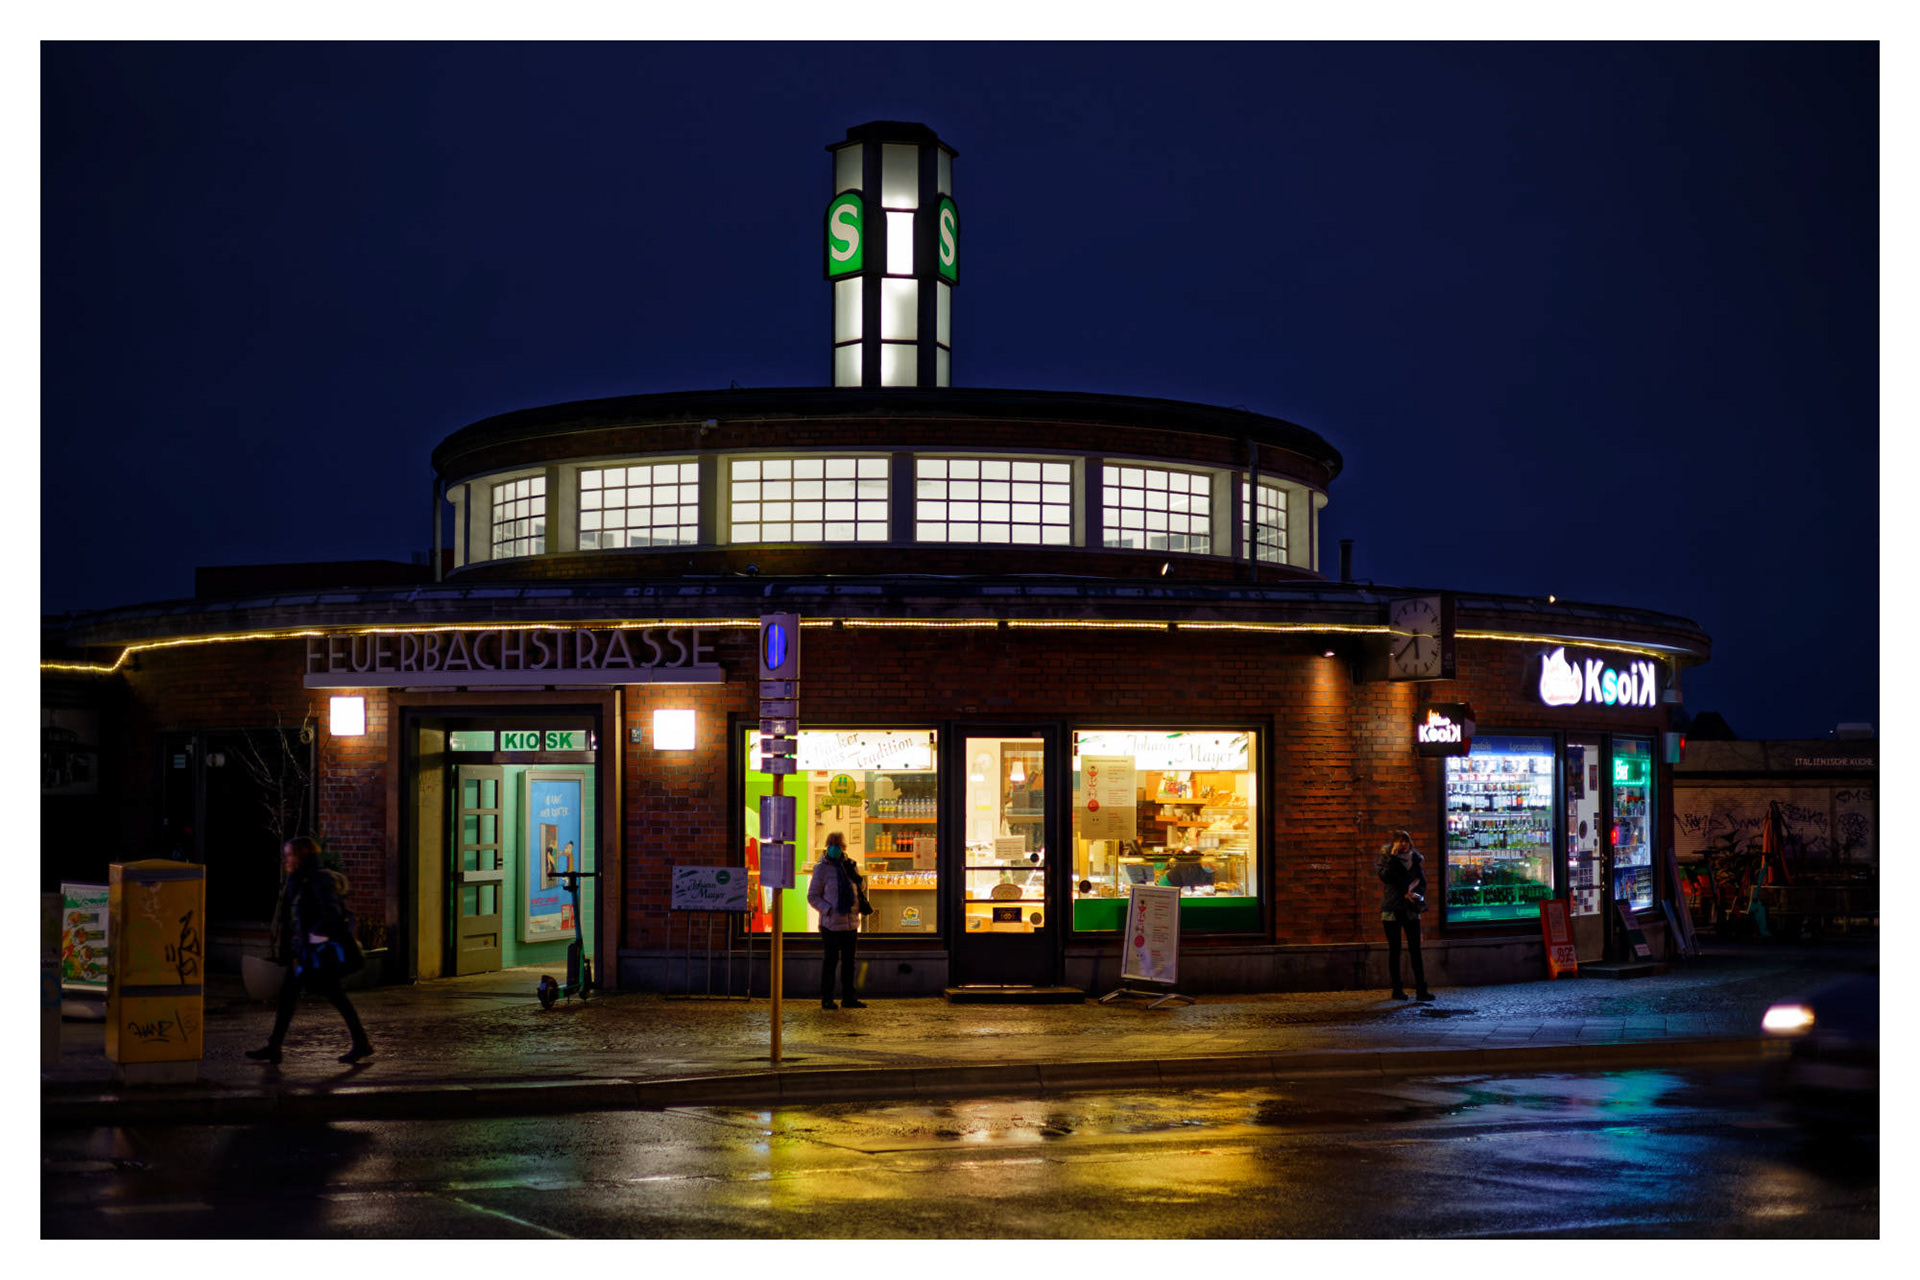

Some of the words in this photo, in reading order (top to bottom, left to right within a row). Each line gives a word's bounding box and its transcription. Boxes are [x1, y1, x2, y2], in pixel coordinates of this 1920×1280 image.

[830, 203, 860, 262] S
[939, 207, 956, 267] S
[306, 627, 717, 673] FEUERBACHSTRASSE
